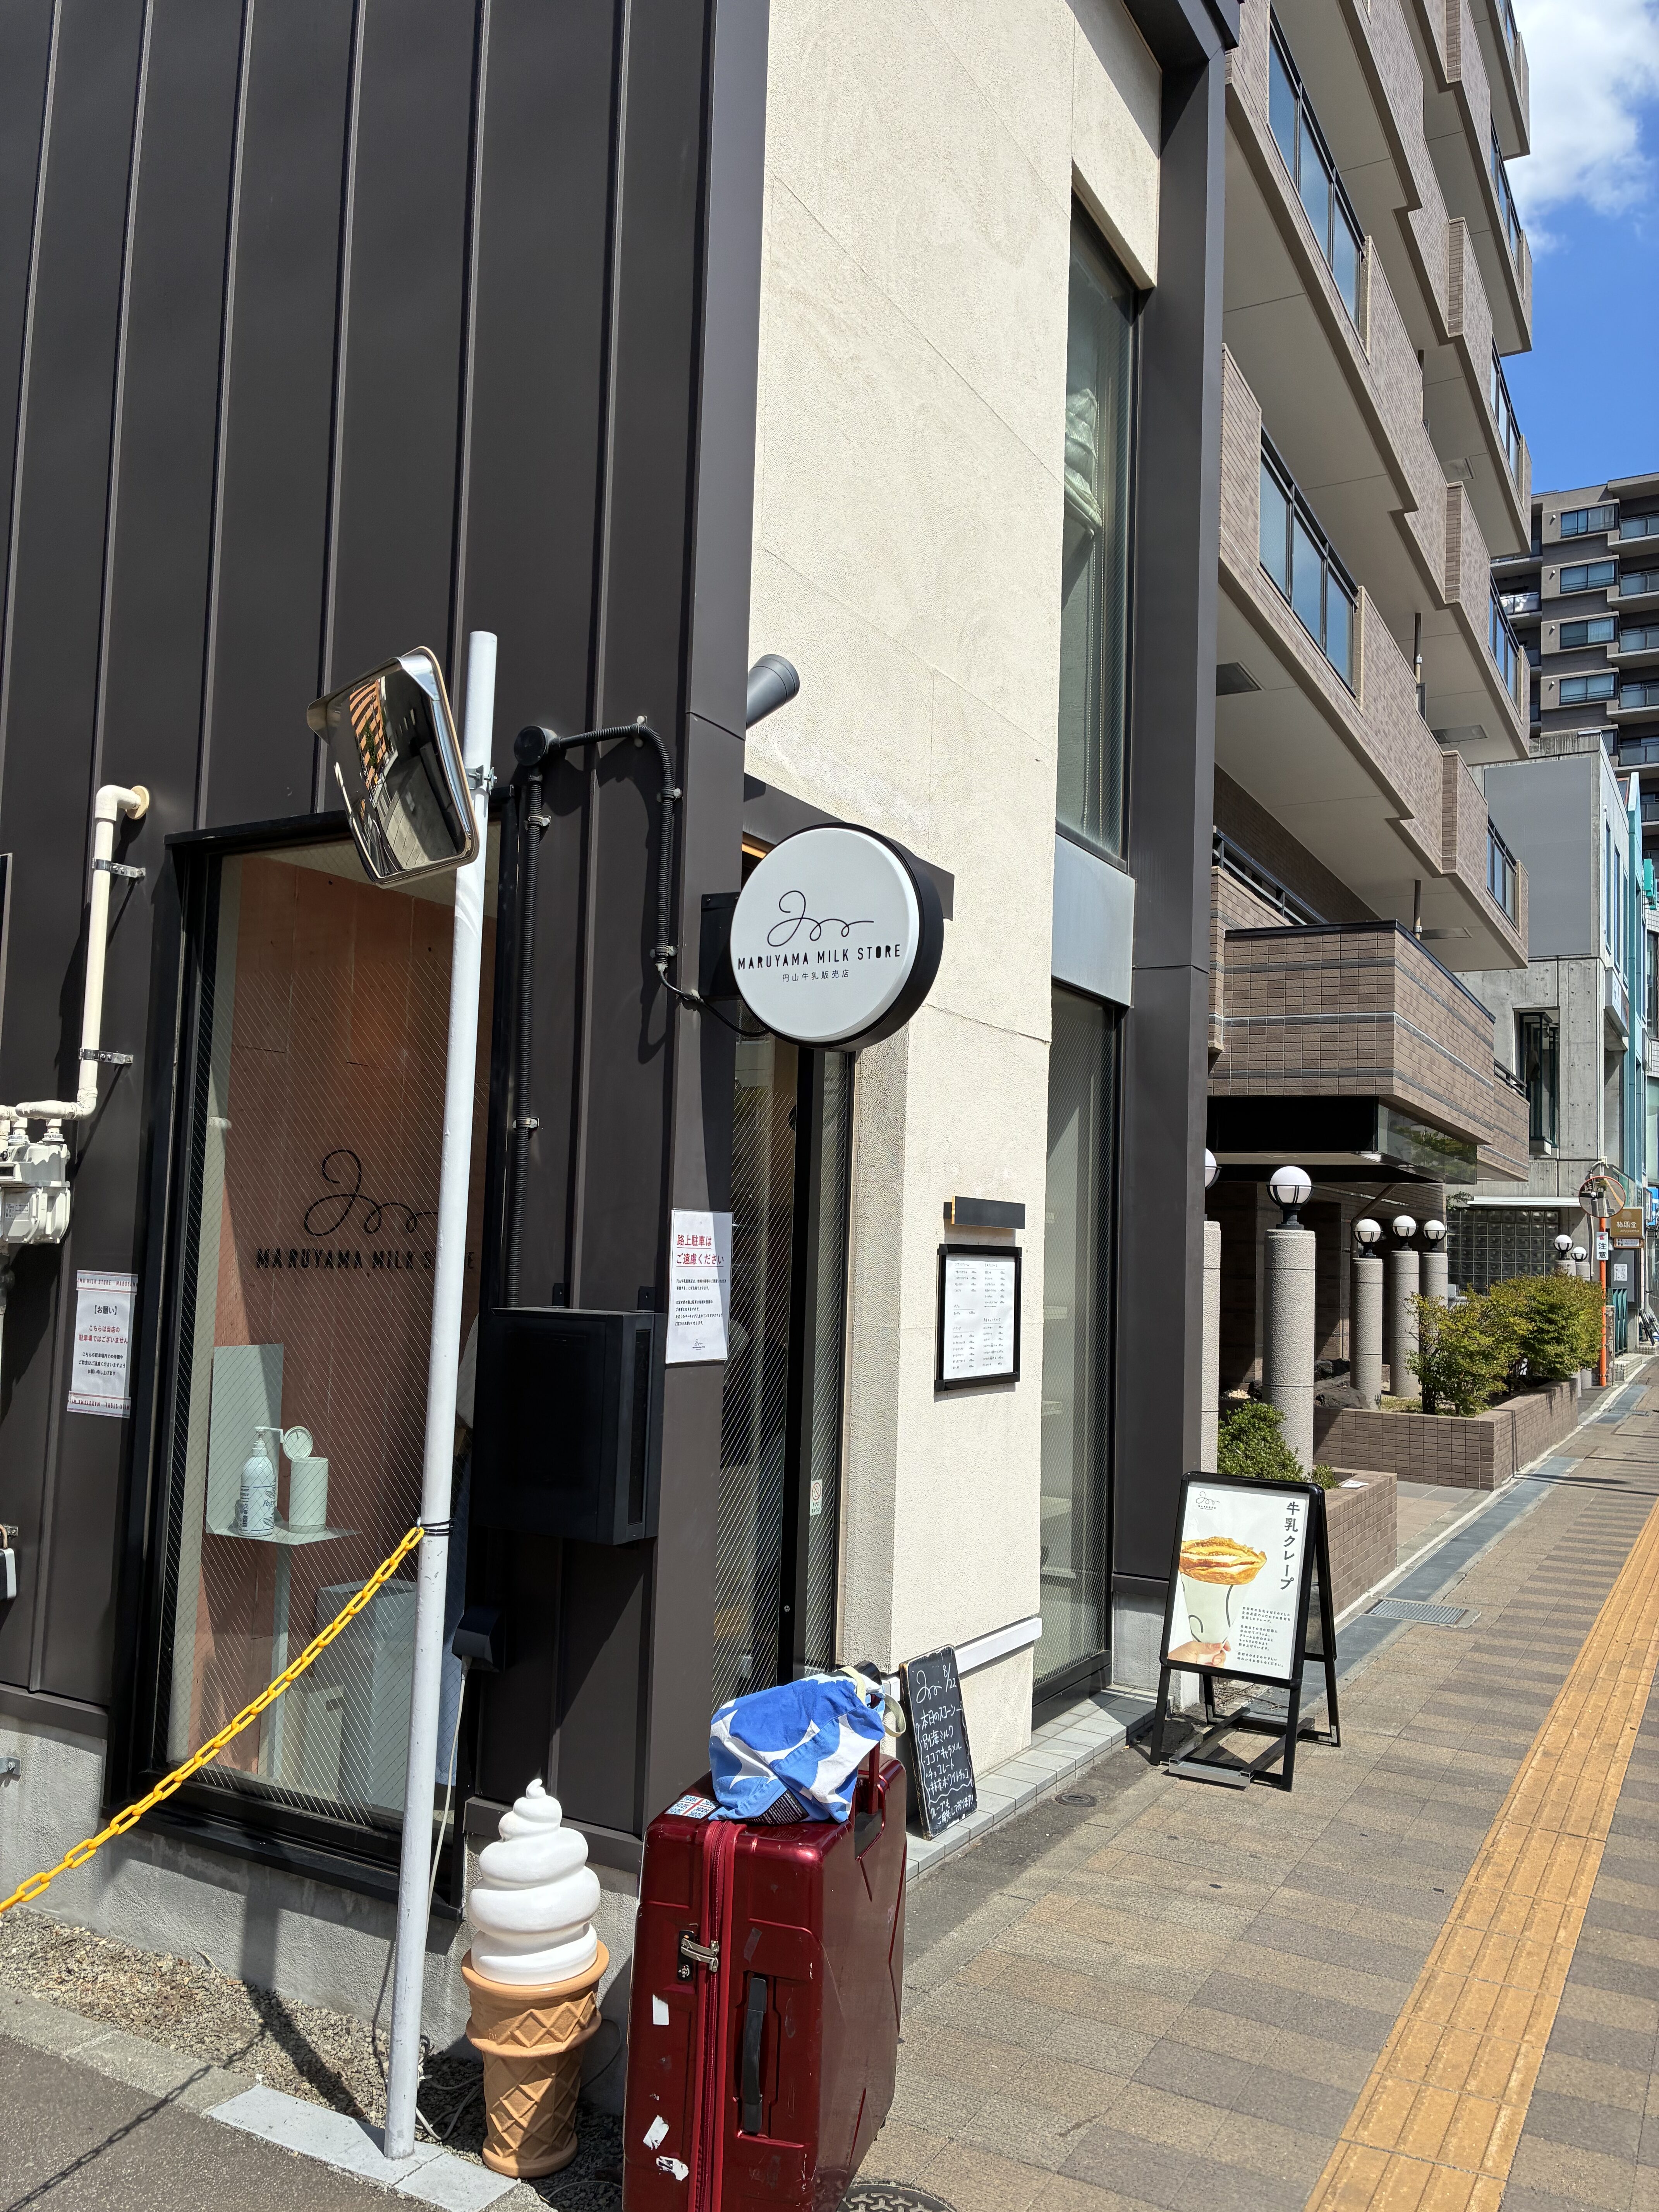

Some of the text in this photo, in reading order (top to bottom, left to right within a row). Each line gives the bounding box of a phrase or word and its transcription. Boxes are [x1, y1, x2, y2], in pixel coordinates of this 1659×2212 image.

[738, 944, 901, 970] MARUYAMA MILK STORE
[782, 969, 850, 982] 円山牛乳販売店
[677, 1234, 712, 1247] 路上駐車は
[256, 1248, 363, 1269] MARUYAMA
[372, 1250, 416, 1269] MILK
[676, 1253, 724, 1265] ご遠慮ください
[1280, 1501, 1300, 1590] 牛乳クレープ
[943, 1662, 957, 1693] 8/22
